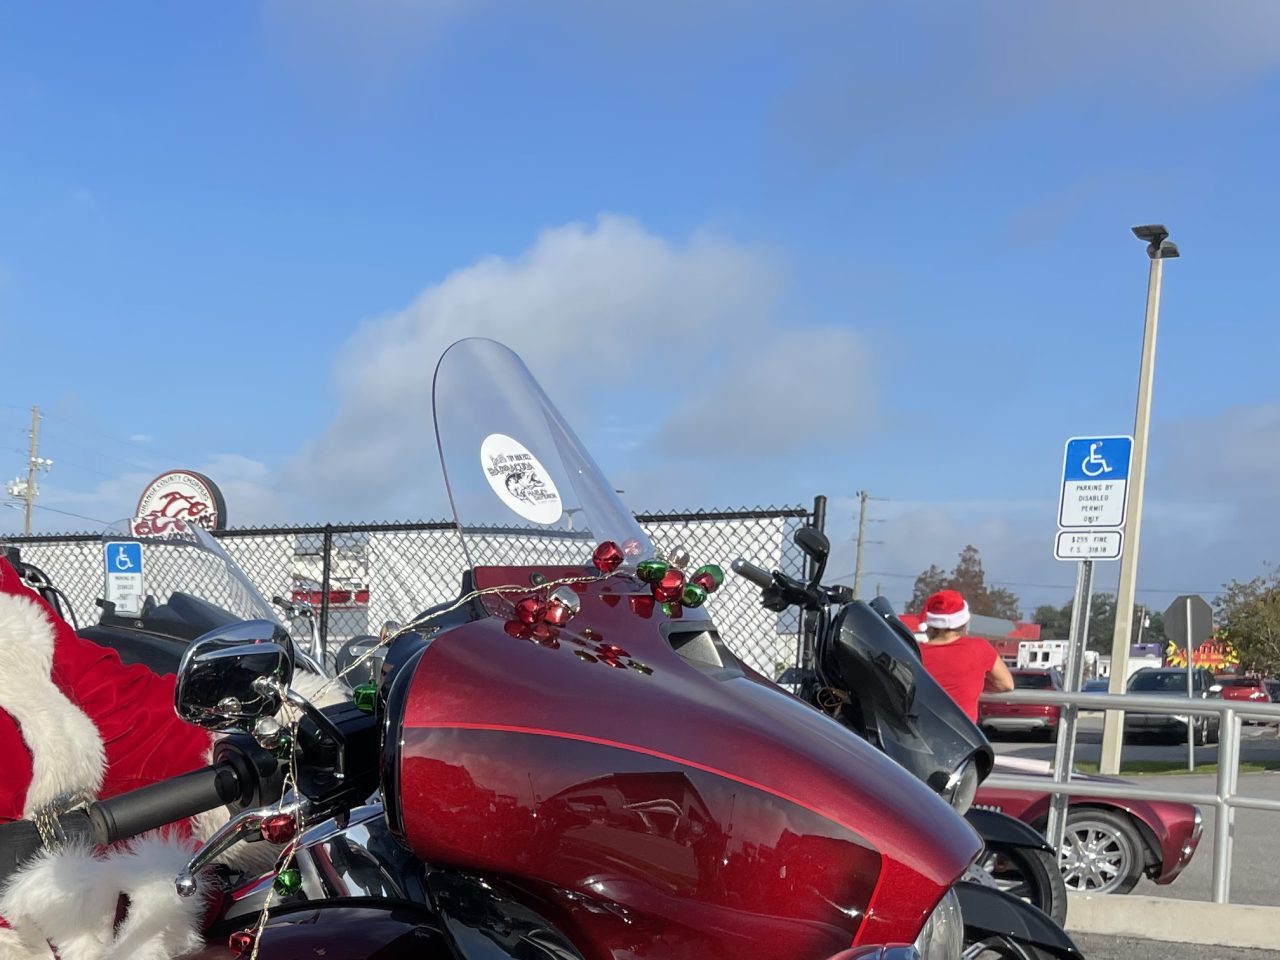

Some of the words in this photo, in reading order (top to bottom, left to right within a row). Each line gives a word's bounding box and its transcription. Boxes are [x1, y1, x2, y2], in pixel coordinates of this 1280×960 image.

[140, 485, 157, 515] ORANGE
[157, 475, 182, 491] COUNTY
[182, 475, 209, 503] CHOPPERS
